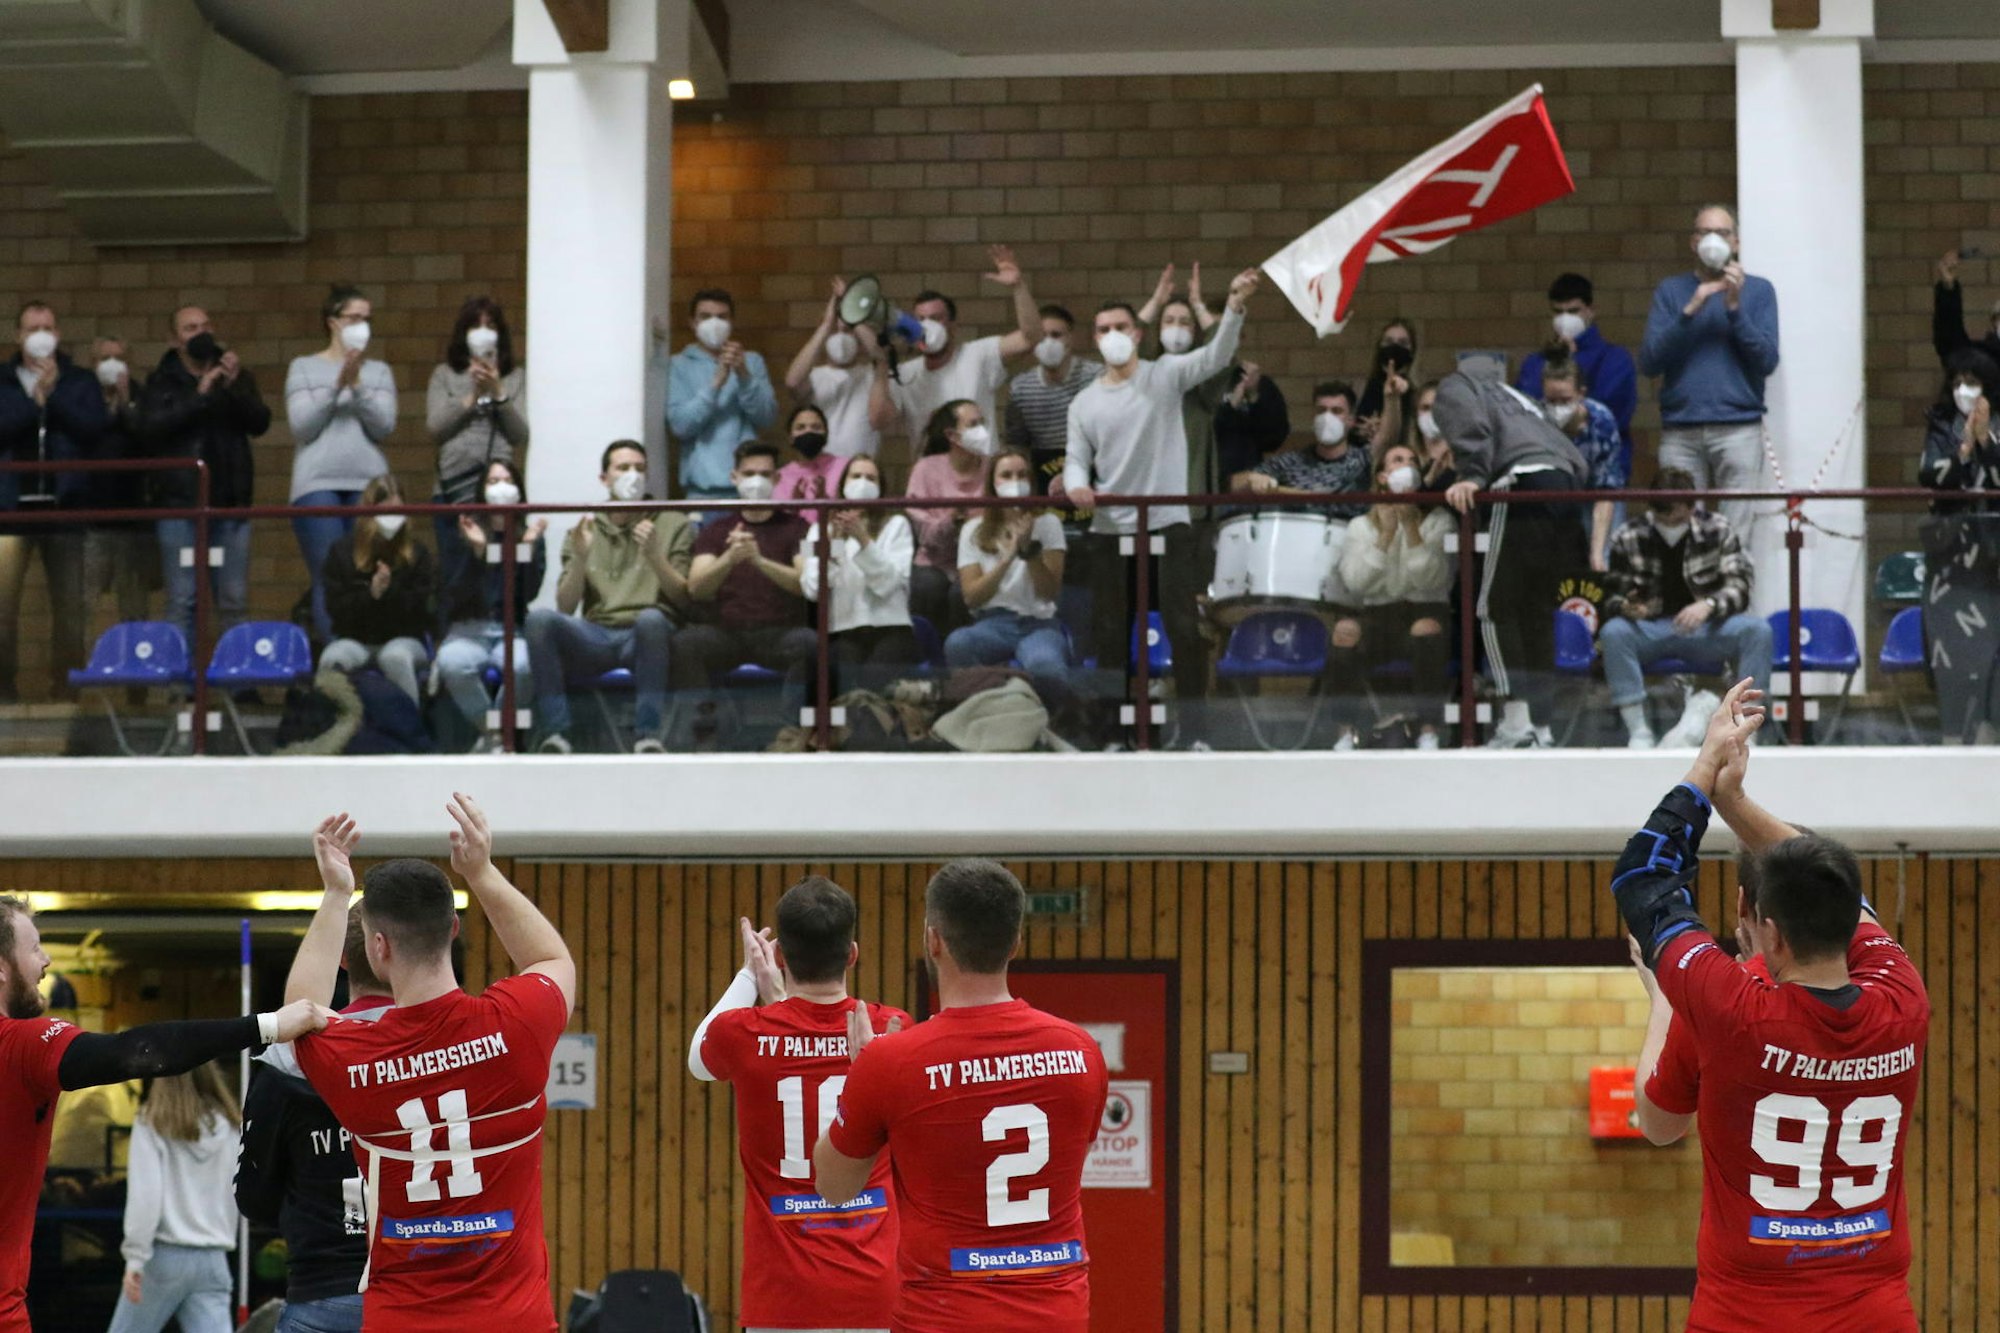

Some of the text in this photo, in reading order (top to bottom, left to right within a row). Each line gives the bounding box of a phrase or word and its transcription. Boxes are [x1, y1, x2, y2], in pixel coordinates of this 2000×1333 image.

[348, 1031, 509, 1088] TV PALMERSHEIM
[758, 1036, 780, 1056] TV
[1761, 1043, 1915, 1081] TV PALMERSHEIM
[555, 1062, 587, 1086] 15
[925, 1050, 1088, 1090] TV PALMERSHEIM
[310, 1128, 331, 1155] TV
[396, 1088, 483, 1203] 11
[1750, 1092, 1902, 1211] 99
[982, 1103, 1050, 1227] 2
[968, 1245, 1071, 1268] Sparda-Bank
